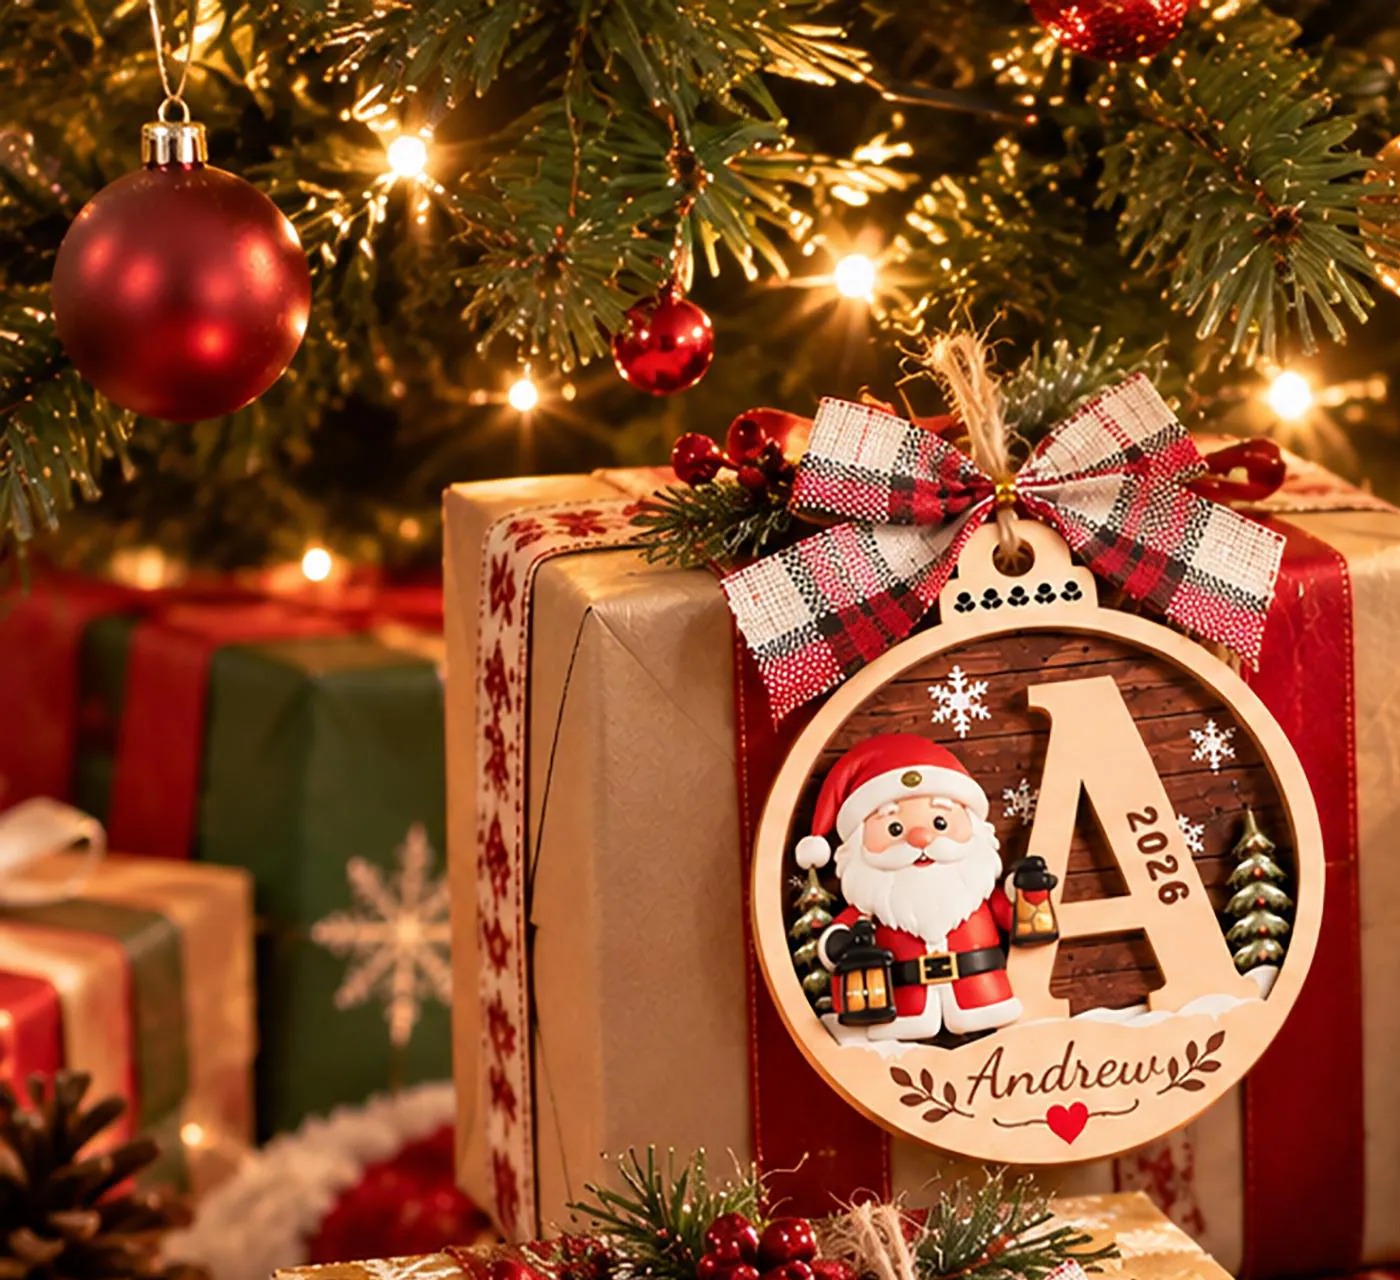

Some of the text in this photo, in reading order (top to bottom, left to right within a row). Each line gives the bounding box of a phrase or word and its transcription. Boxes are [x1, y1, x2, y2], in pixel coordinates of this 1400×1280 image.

[1005, 675, 1262, 1018] A
[1126, 805, 1190, 906] 2026
[967, 1040, 1166, 1106] Andrew
